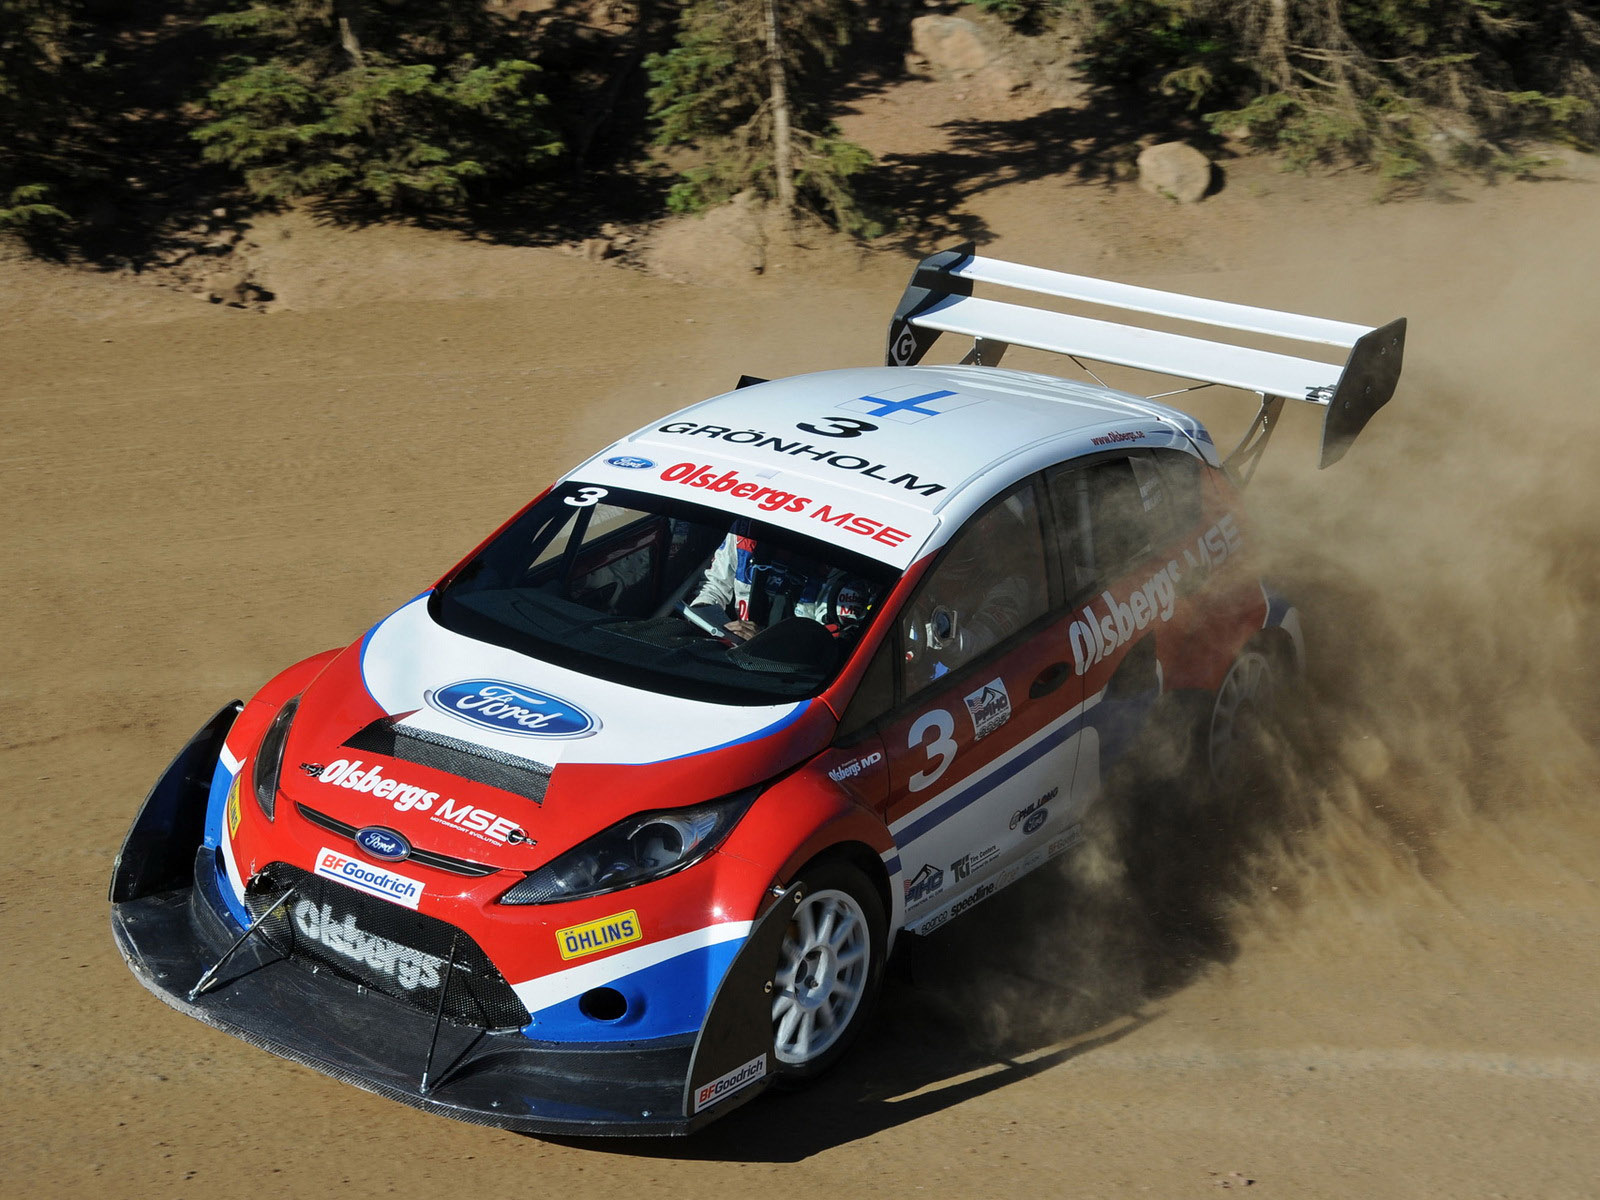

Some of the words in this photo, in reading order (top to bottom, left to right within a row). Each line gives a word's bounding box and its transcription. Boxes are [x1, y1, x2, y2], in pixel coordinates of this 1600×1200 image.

[896, 333, 912, 361] G
[796, 416, 879, 439] 3
[658, 422, 946, 497] GRÖNHOLM
[563, 486, 609, 507] 3
[659, 462, 813, 512] Olsbergs
[809, 505, 912, 548] MSE
[456, 685, 563, 729] Ford
[828, 761, 861, 782] Olsbergs
[860, 752, 882, 769] MD
[907, 708, 958, 793] 3
[318, 758, 441, 812] Olsbergs
[434, 798, 521, 843] MSE
[364, 832, 395, 854] Ford
[429, 815, 469, 835] MOTORSPORT
[468, 830, 504, 848] EVOLUTION
[321, 853, 416, 898] BFGoodrich
[950, 882, 995, 919] speedline
[564, 919, 635, 953] ÖHLINS
[921, 910, 948, 933] sparco
[294, 899, 443, 991] Olsbergs
[698, 1059, 764, 1104] BFGoodrich
